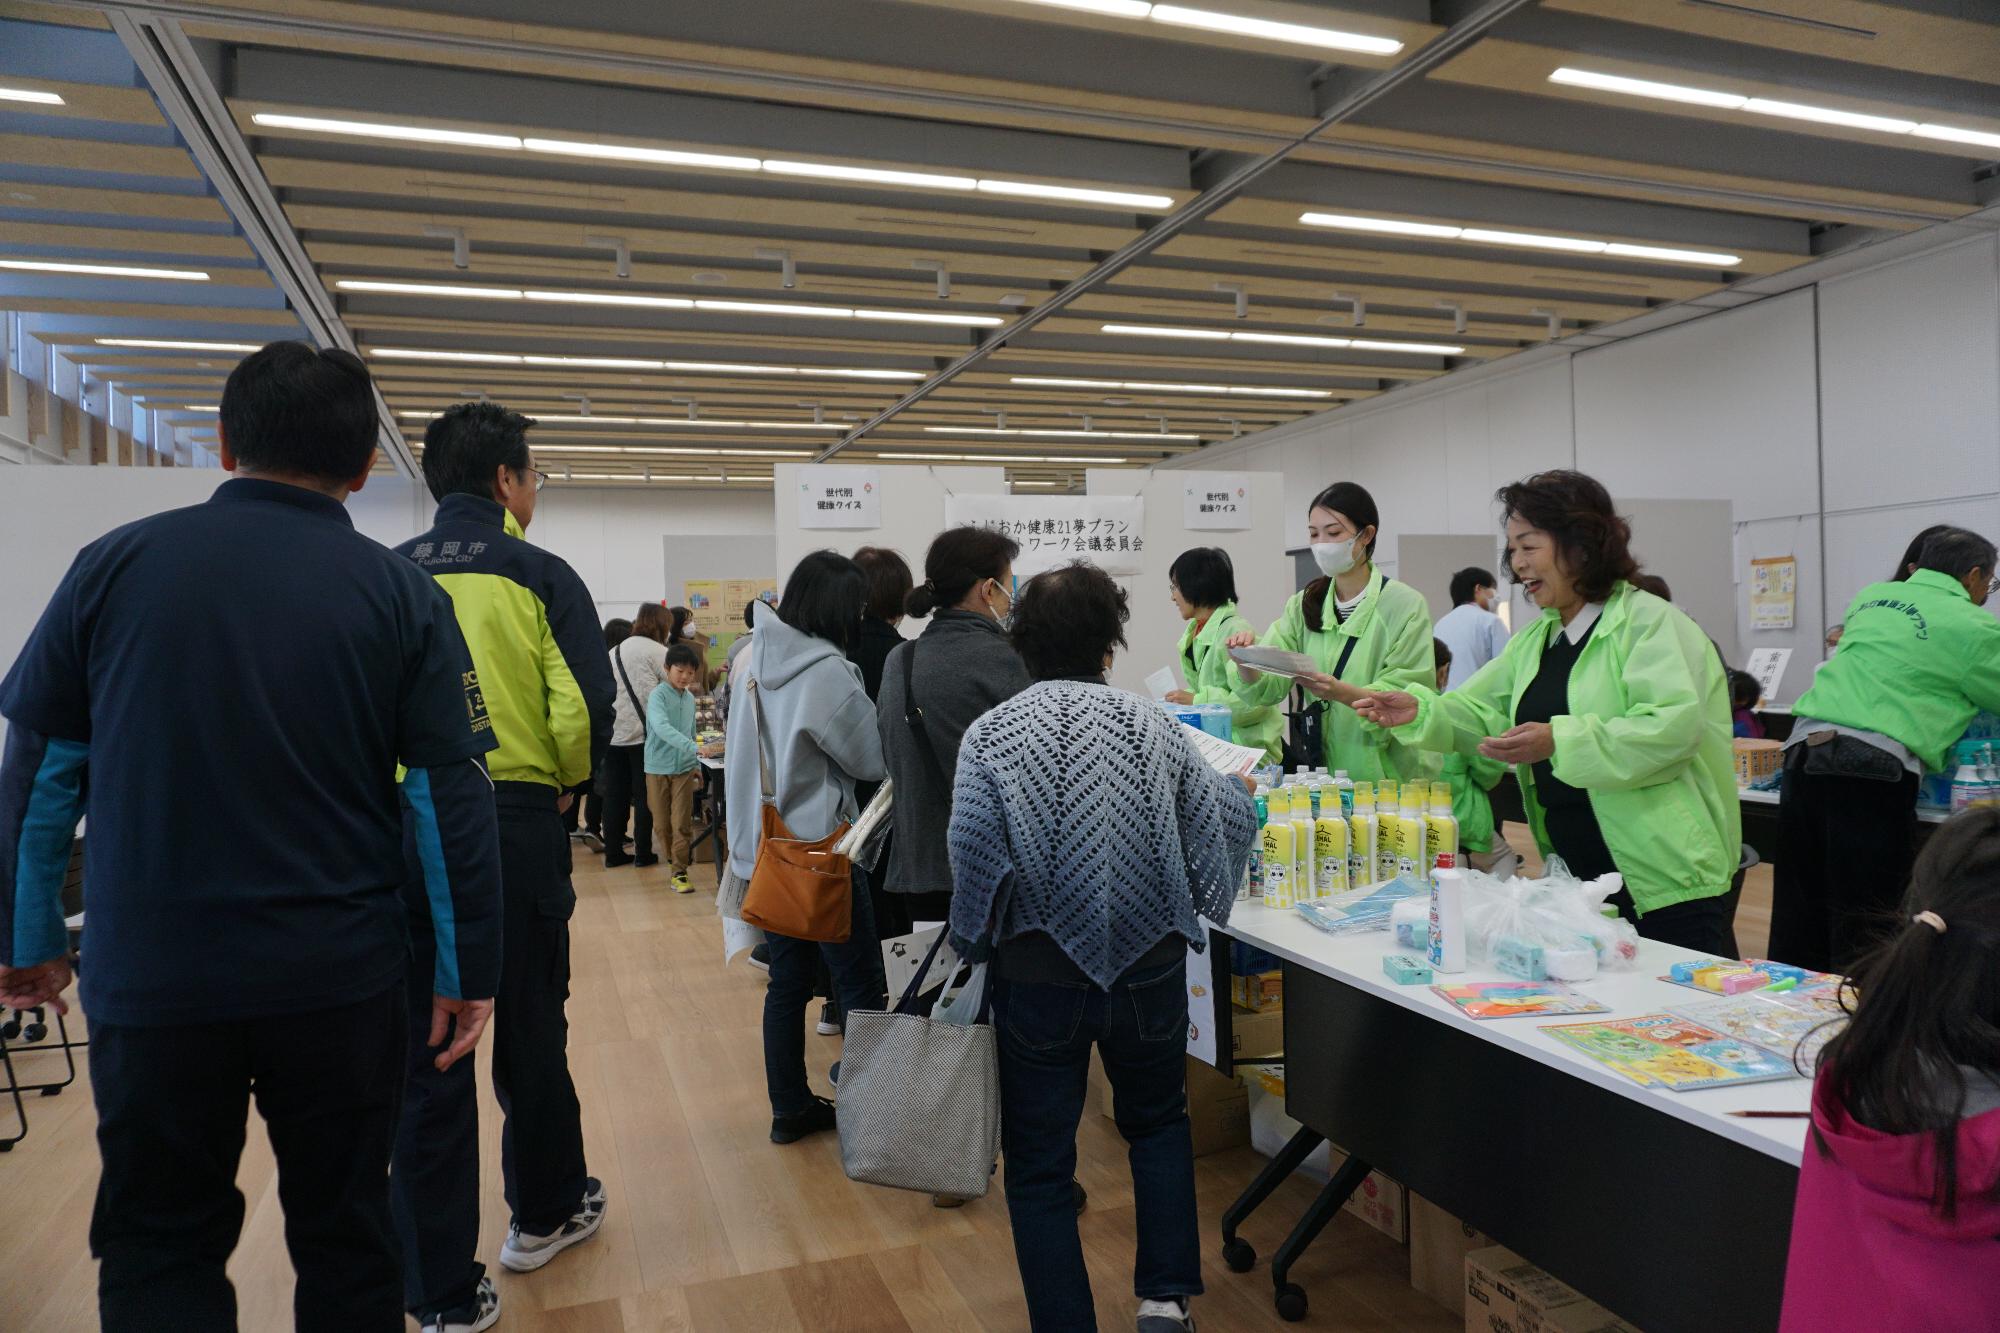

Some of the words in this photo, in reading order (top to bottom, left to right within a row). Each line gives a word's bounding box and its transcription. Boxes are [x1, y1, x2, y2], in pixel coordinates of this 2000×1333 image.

[410, 541, 488, 559] 藤岡市
[417, 556, 453, 566] Fujioka
